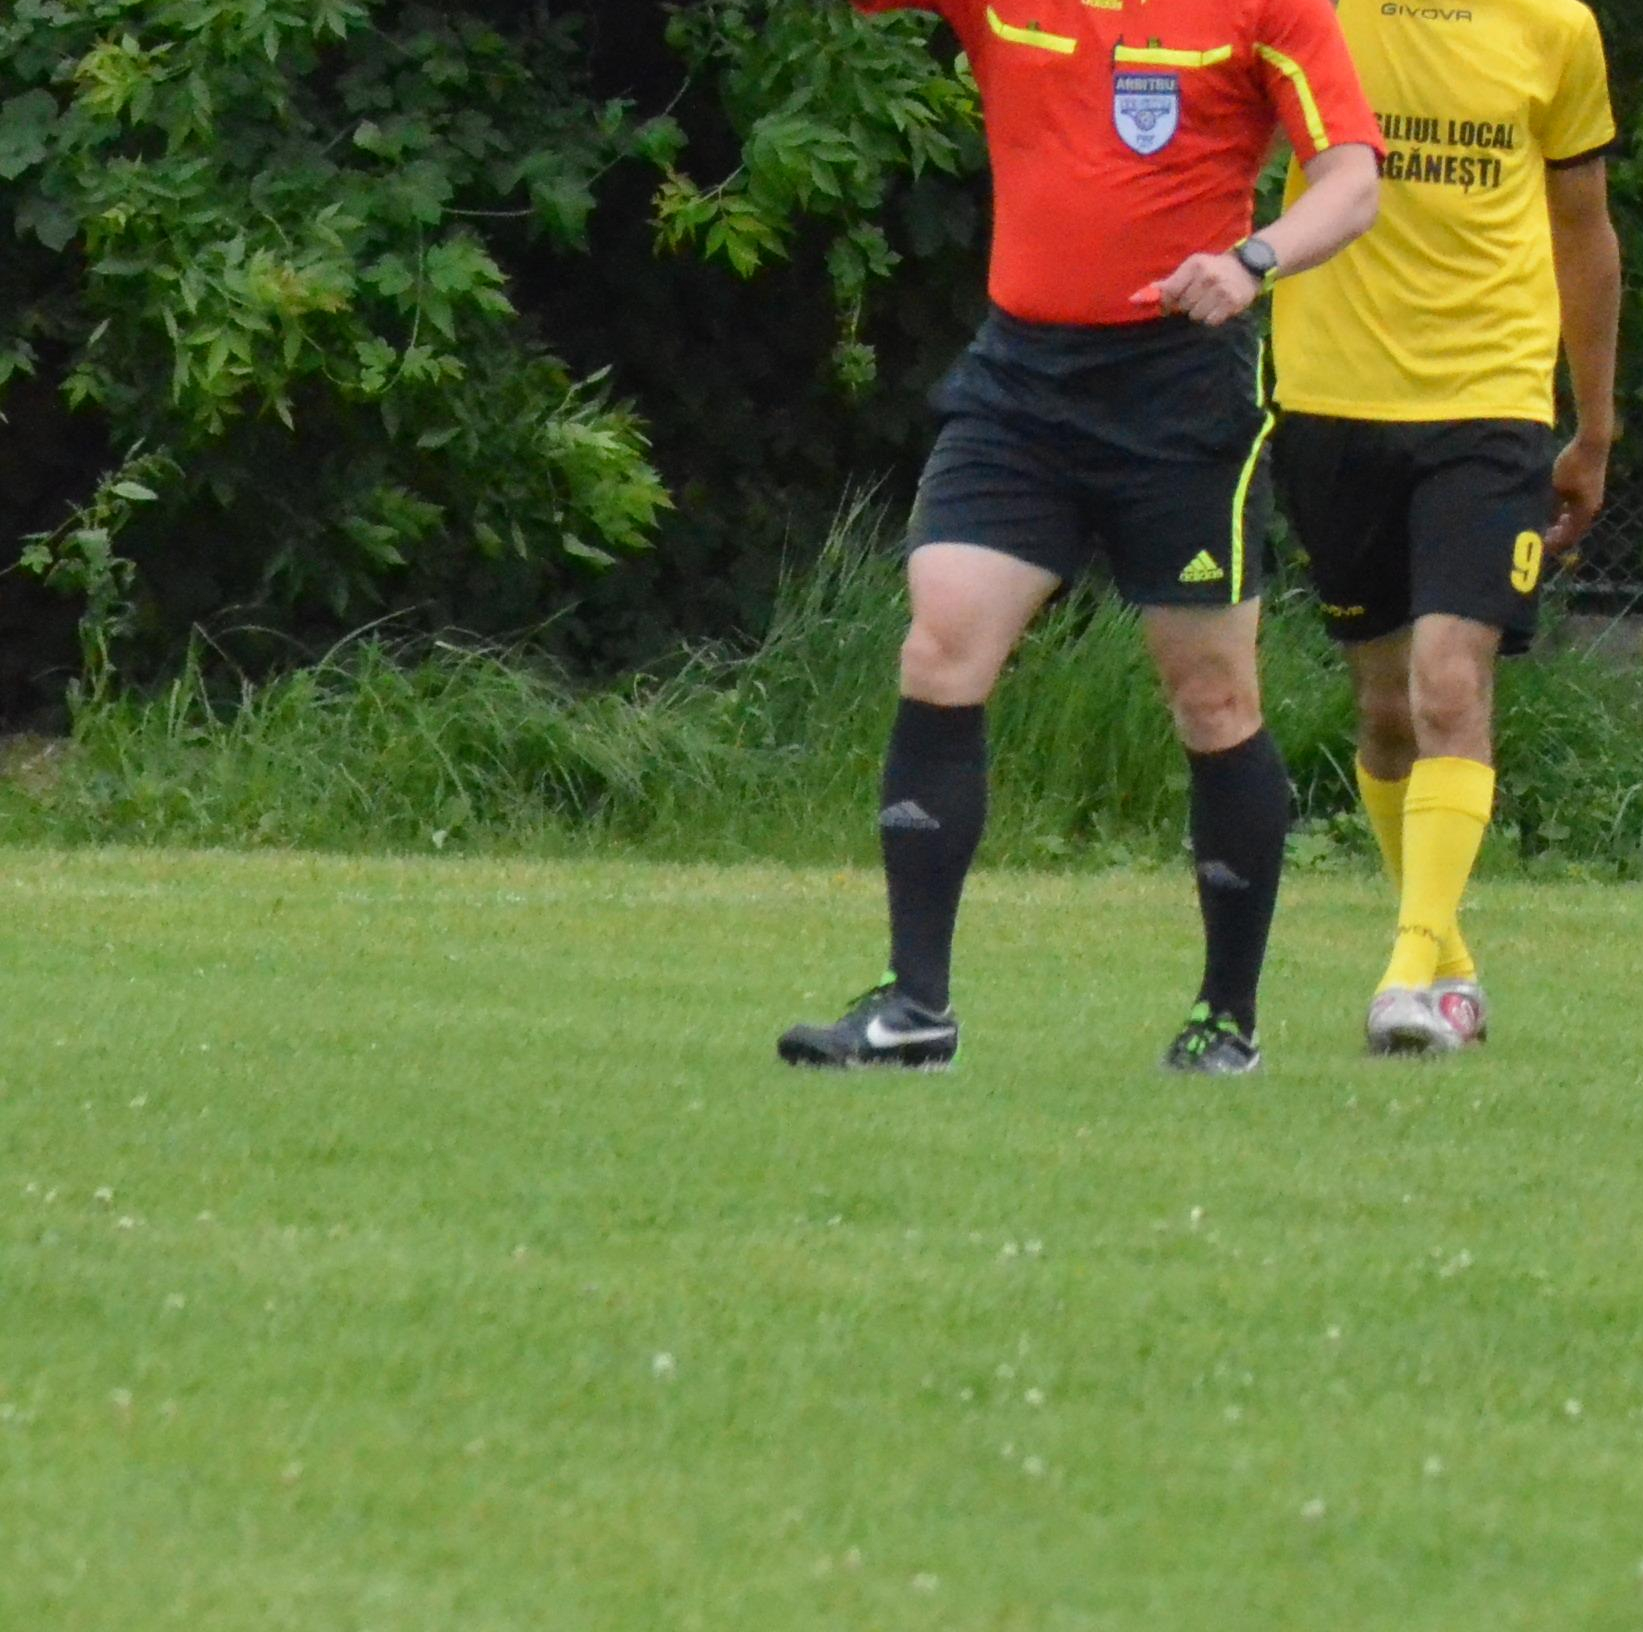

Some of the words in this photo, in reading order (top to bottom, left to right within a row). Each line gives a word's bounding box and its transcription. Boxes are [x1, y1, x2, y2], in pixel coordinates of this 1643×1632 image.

[1381, 2, 1473, 22] GIVOVA
[1448, 120, 1515, 150] LOCAL
[1511, 530, 1544, 593] 9
